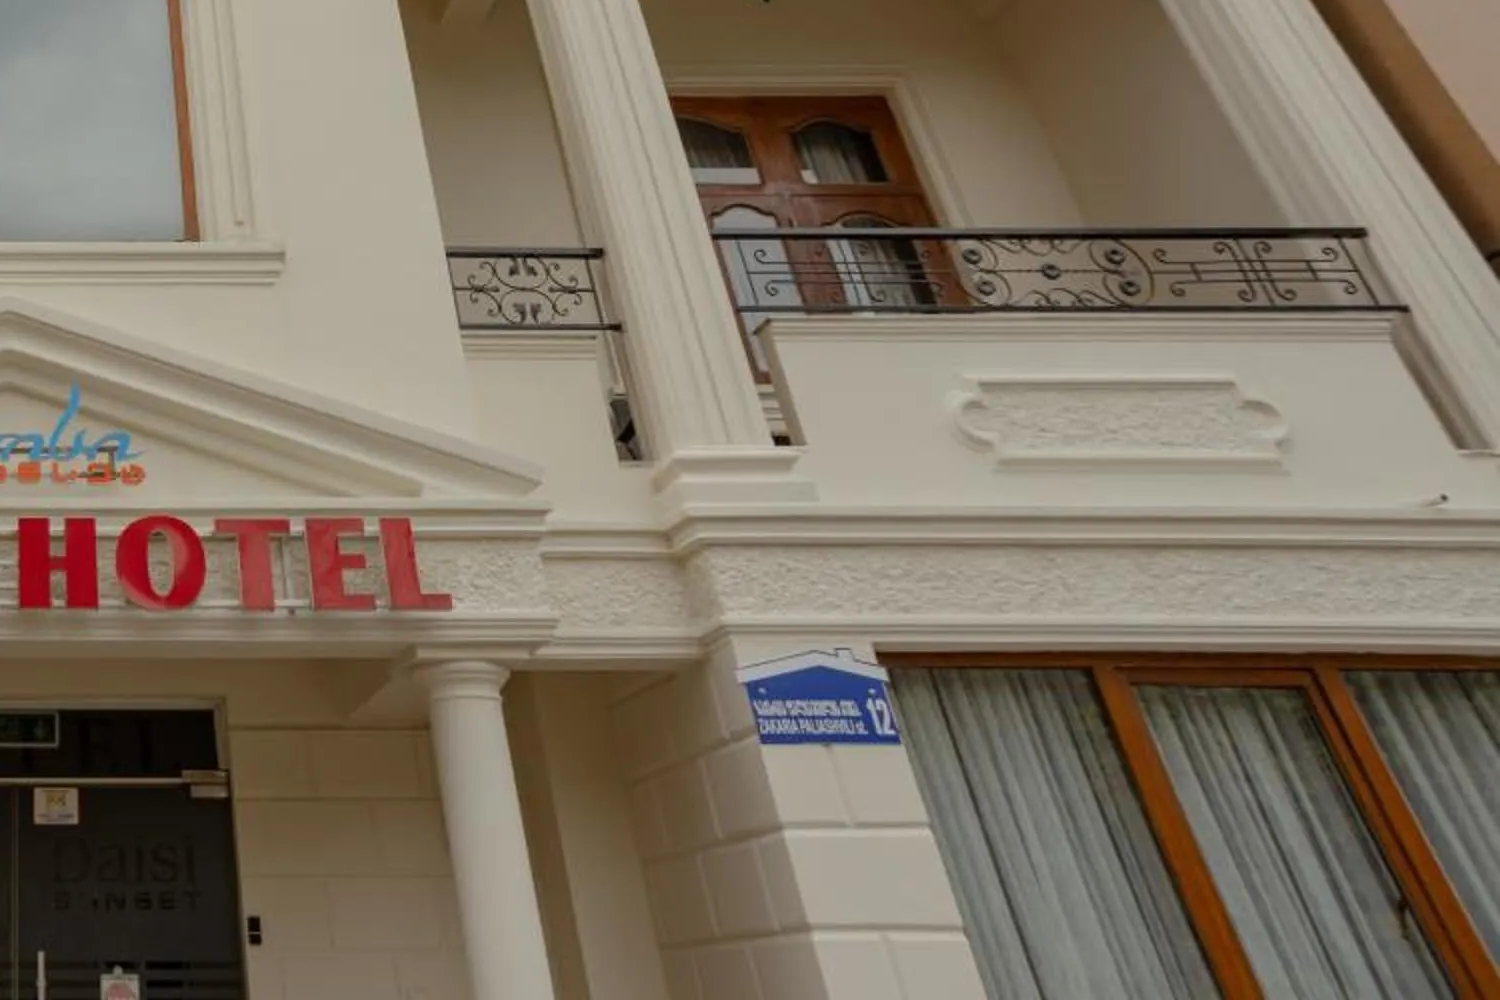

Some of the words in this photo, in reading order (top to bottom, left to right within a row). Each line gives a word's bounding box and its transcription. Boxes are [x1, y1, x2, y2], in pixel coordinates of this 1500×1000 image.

[17, 515, 453, 612] HOTEL
[867, 699, 896, 735] 12
[53, 834, 196, 883] Daisi
